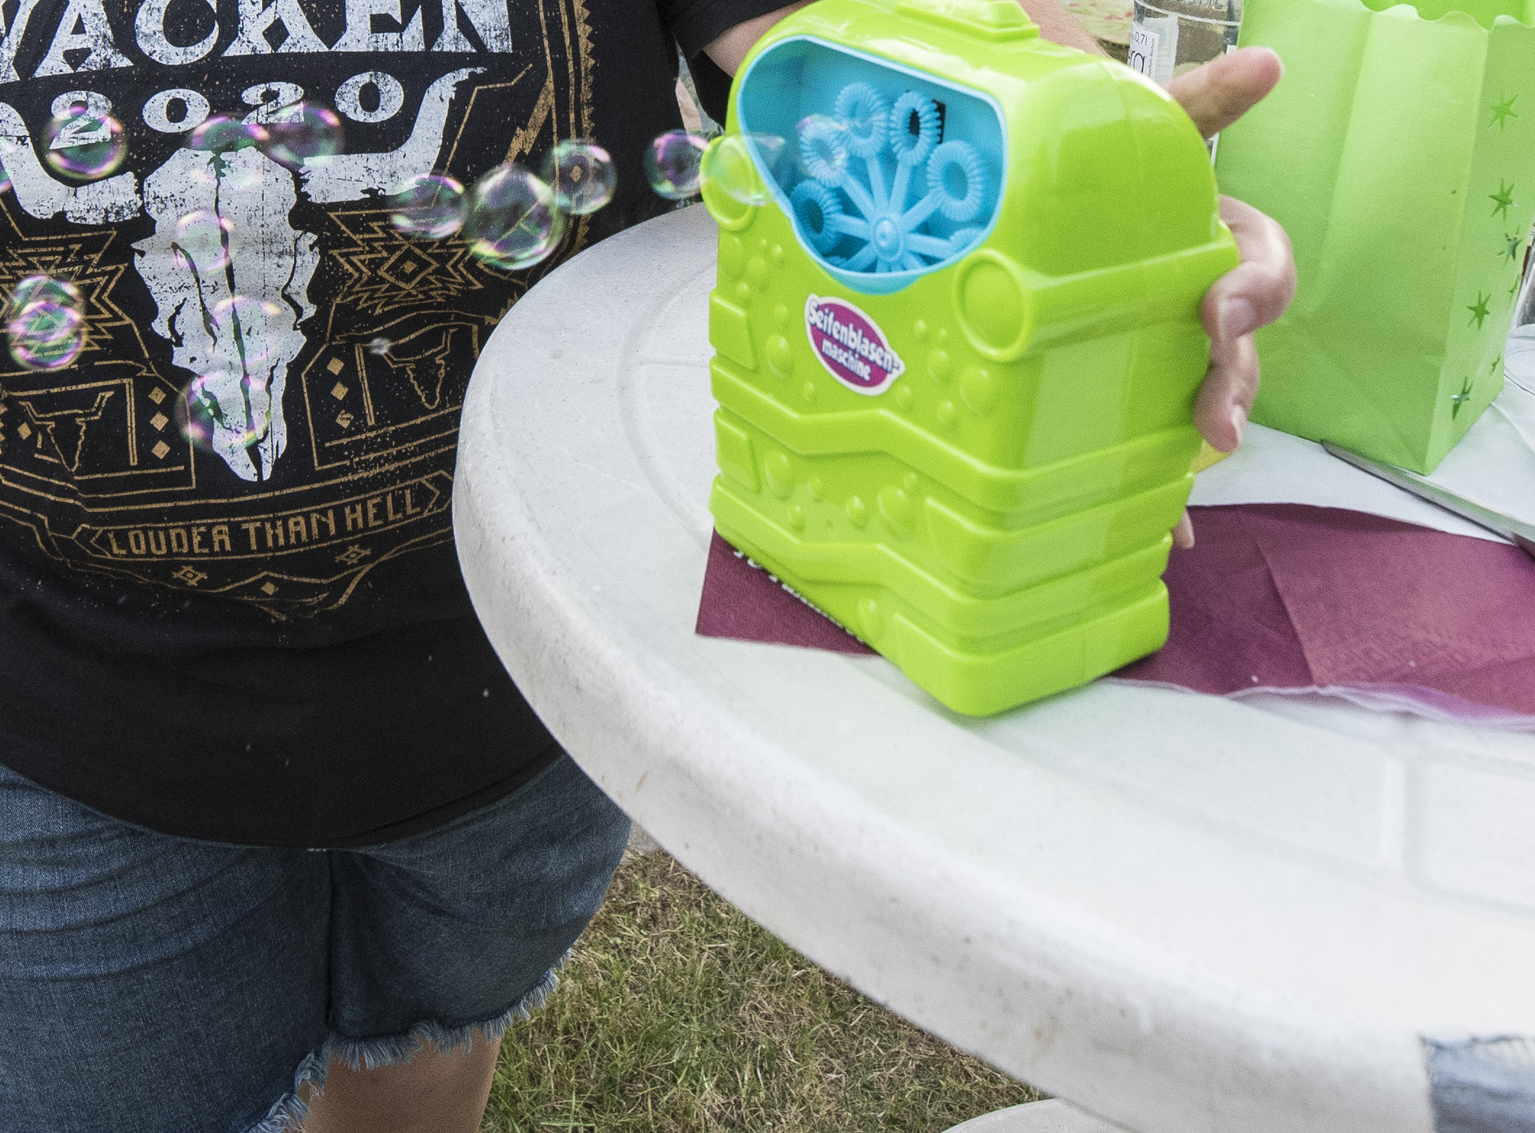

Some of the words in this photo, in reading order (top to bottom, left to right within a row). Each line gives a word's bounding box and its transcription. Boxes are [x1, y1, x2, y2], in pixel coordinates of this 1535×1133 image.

[50, 71, 404, 150] 2020
[822, 338, 871, 381] maschine
[109, 524, 231, 555] LOUDER
[241, 509, 336, 550] THAN
[345, 487, 421, 532] HELL
